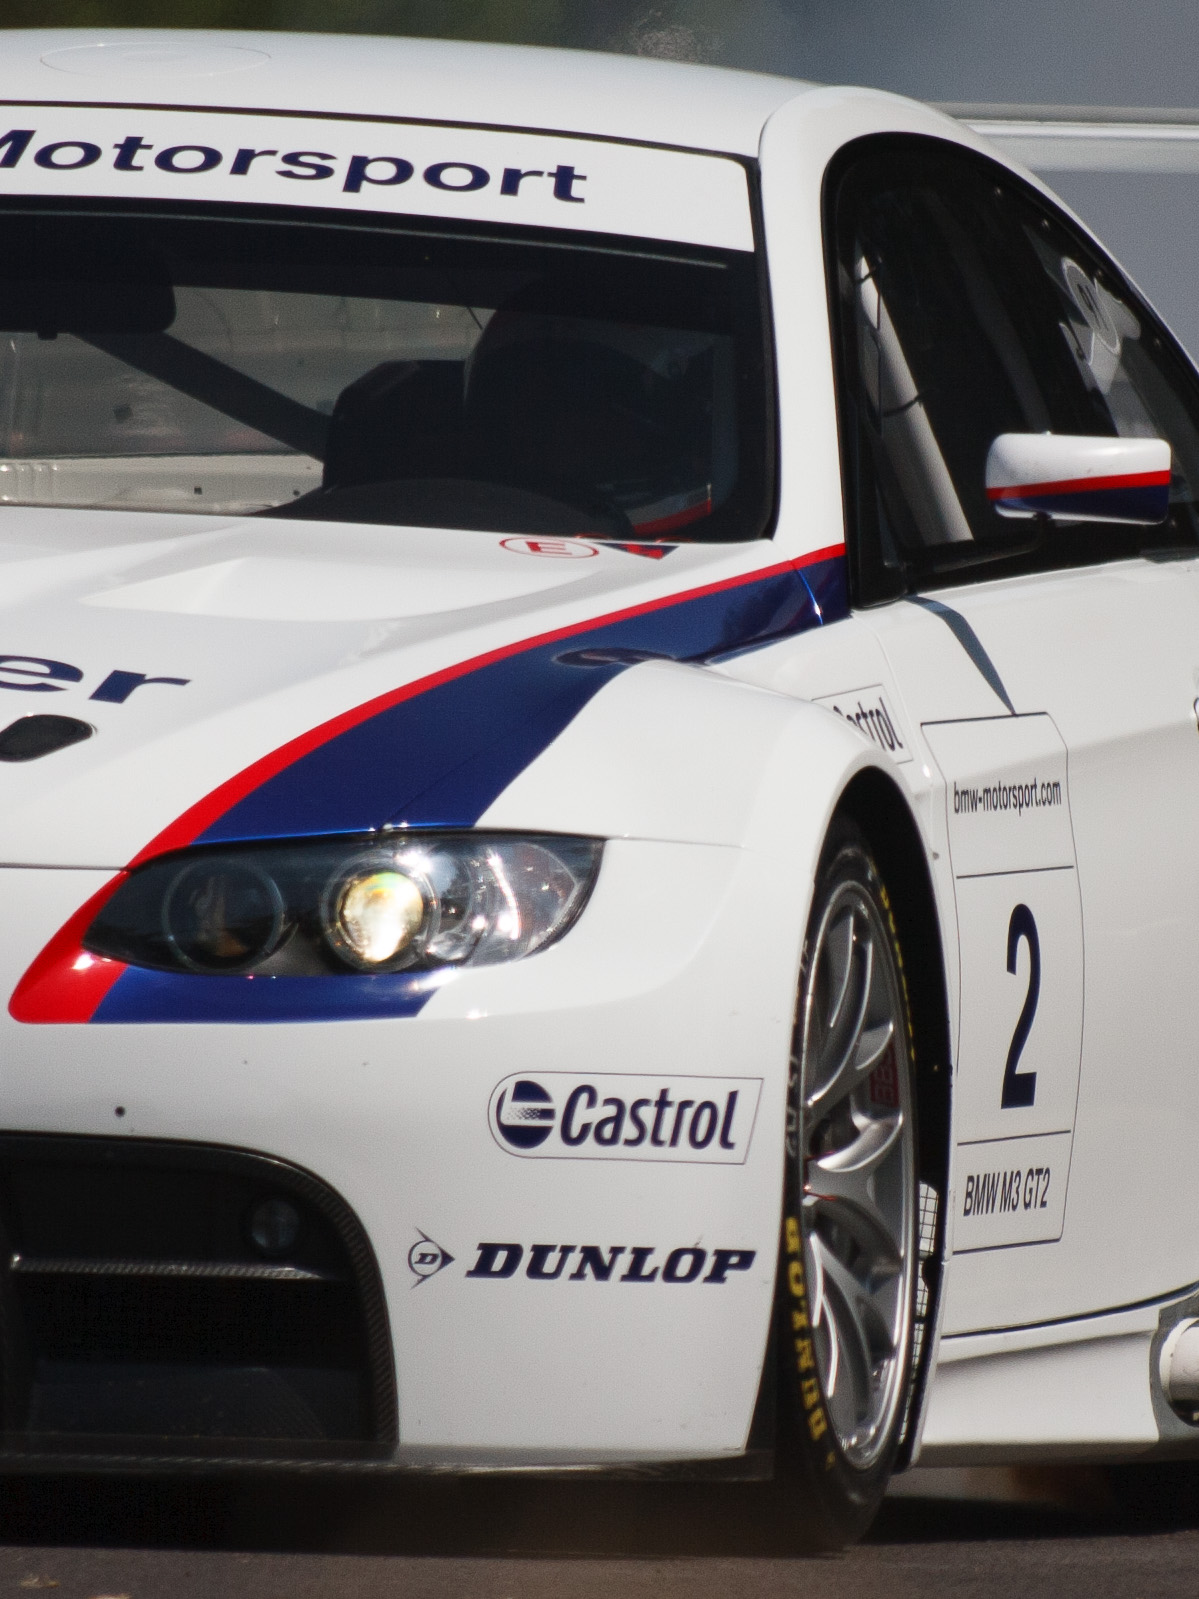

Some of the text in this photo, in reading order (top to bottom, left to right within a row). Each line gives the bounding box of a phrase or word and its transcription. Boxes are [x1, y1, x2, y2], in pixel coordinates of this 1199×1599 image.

[954, 778, 1062, 816] bmw-motorsport.com
[1000, 903, 1041, 1109] 2
[561, 1085, 739, 1150] Castrol
[964, 1168, 1051, 1216] BMW M3 GT2
[413, 1242, 757, 1284] D DUNLOP
